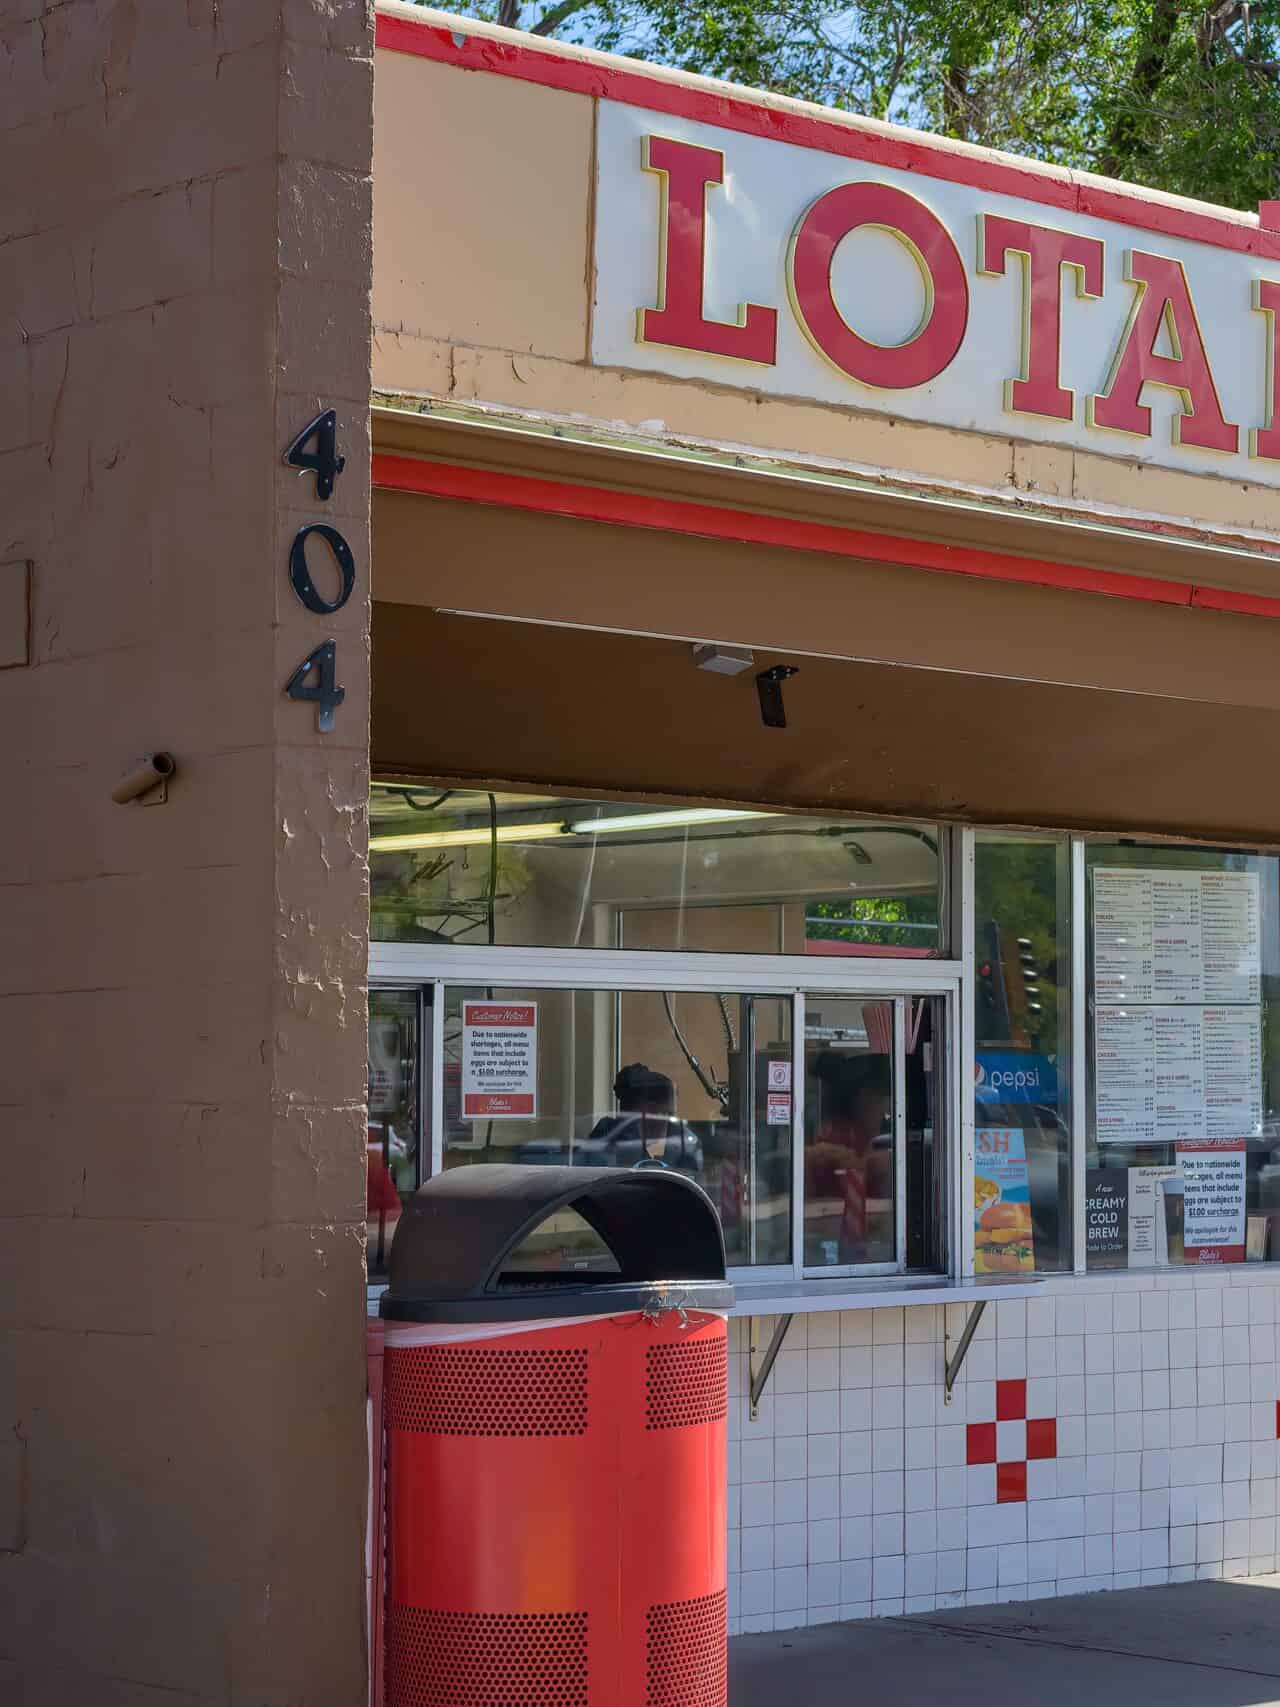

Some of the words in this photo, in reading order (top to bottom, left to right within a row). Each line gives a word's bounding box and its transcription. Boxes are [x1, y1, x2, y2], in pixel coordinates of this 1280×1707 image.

[281, 407, 355, 735] 404
[991, 1067, 1040, 1091] pepsi
[976, 1131, 1010, 1153] SH
[1197, 1160, 1203, 1168] to
[1205, 1159, 1240, 1168] nationwide
[1216, 1172, 1224, 1180] all
[1202, 1184, 1215, 1192] that
[1217, 1184, 1239, 1192] include
[1184, 1197, 1196, 1207] ggs
[1197, 1197, 1208, 1205] are
[1210, 1195, 1233, 1206] subject
[1090, 1212, 1118, 1224] COLD
[1088, 1226, 1119, 1239] BREW
